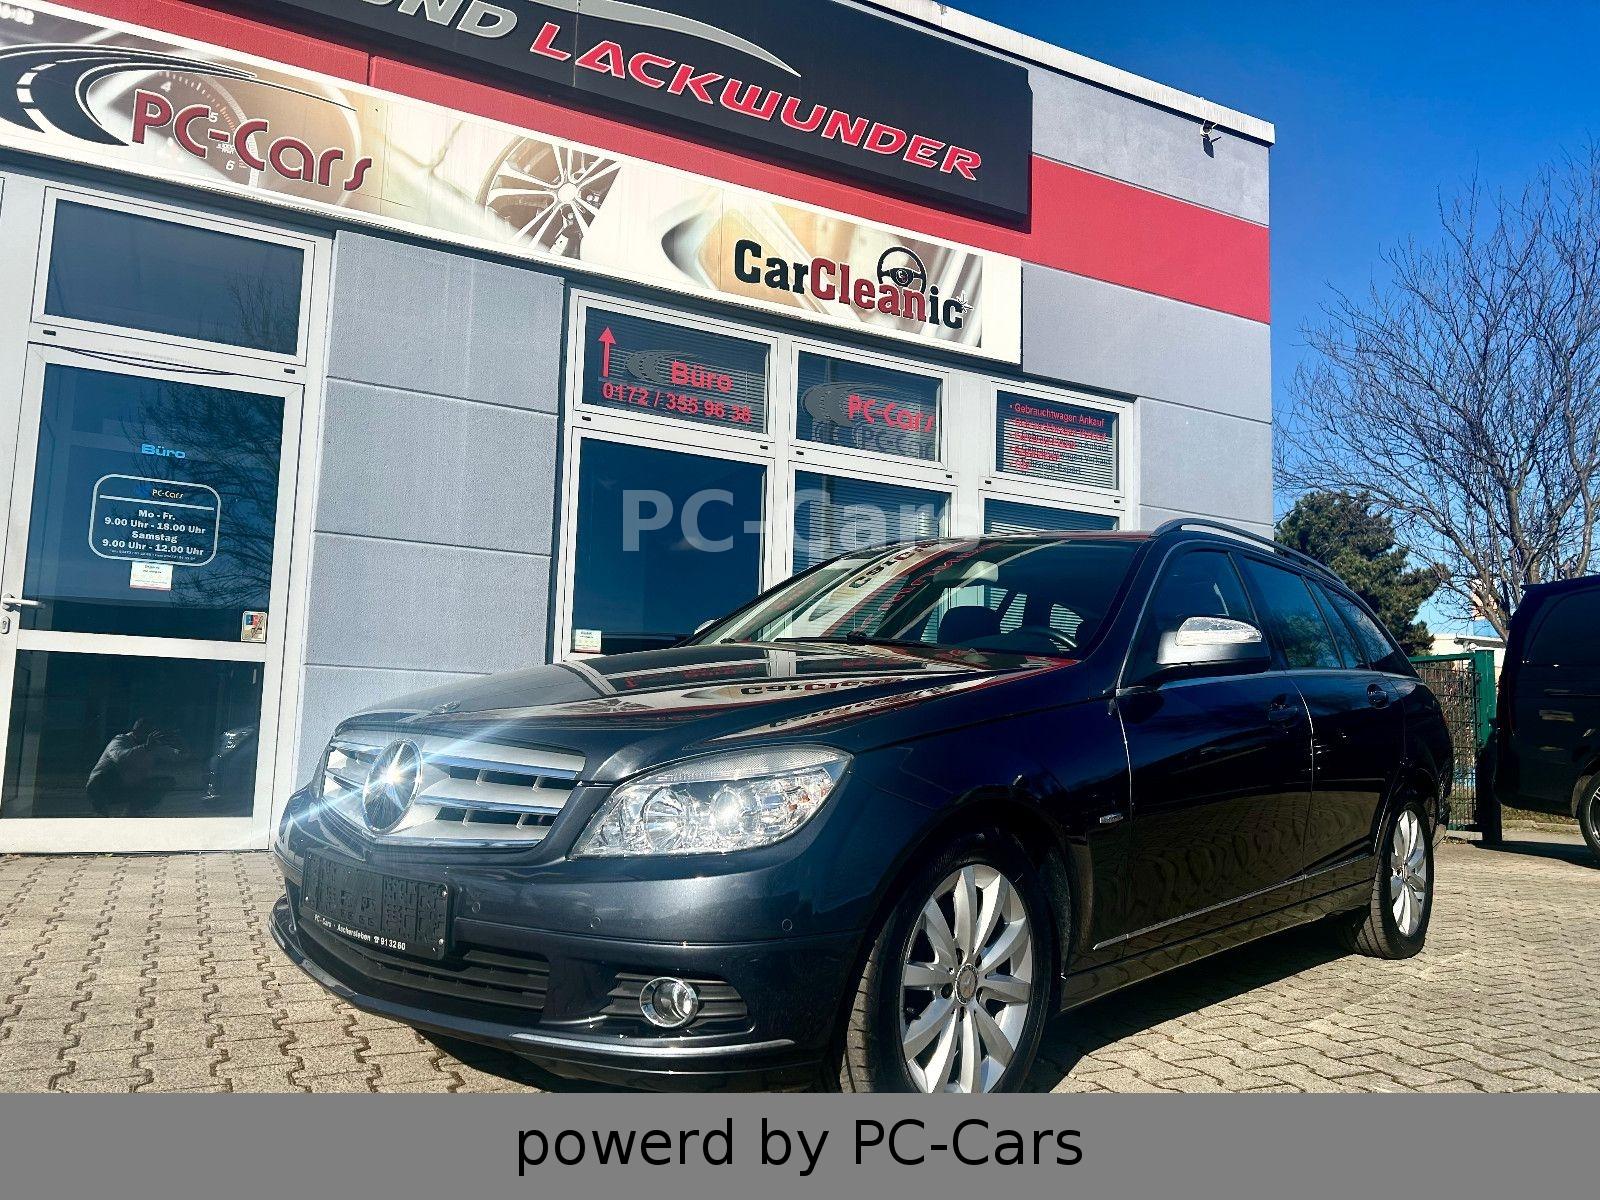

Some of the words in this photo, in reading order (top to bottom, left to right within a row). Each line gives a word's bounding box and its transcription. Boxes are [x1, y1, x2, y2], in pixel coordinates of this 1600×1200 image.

[530, 22, 982, 181] LACKWUNDER
[132, 88, 373, 191] PC-Cars
[734, 239, 965, 329] CarCleanic
[671, 361, 733, 393] Büro
[602, 382, 649, 407] 0172
[848, 393, 936, 433] PC-Cars
[1014, 403, 1077, 423] Gebrauchtwagen
[1080, 414, 1105, 427] Ankauf
[141, 443, 186, 459] Büro
[152, 488, 184, 499] PC-Cars
[104, 517, 128, 526] 9.00
[130, 519, 149, 529] Uhr
[156, 522, 186, 532] 18.00
[188, 525, 206, 534] Uhr
[138, 510, 154, 518] Mo
[162, 512, 176, 520] Fr.
[102, 539, 126, 548] 9.00
[128, 541, 147, 550] Uhr
[155, 543, 184, 553] 12.00
[186, 546, 204, 556] Uhr
[131, 530, 178, 543] Samstag
